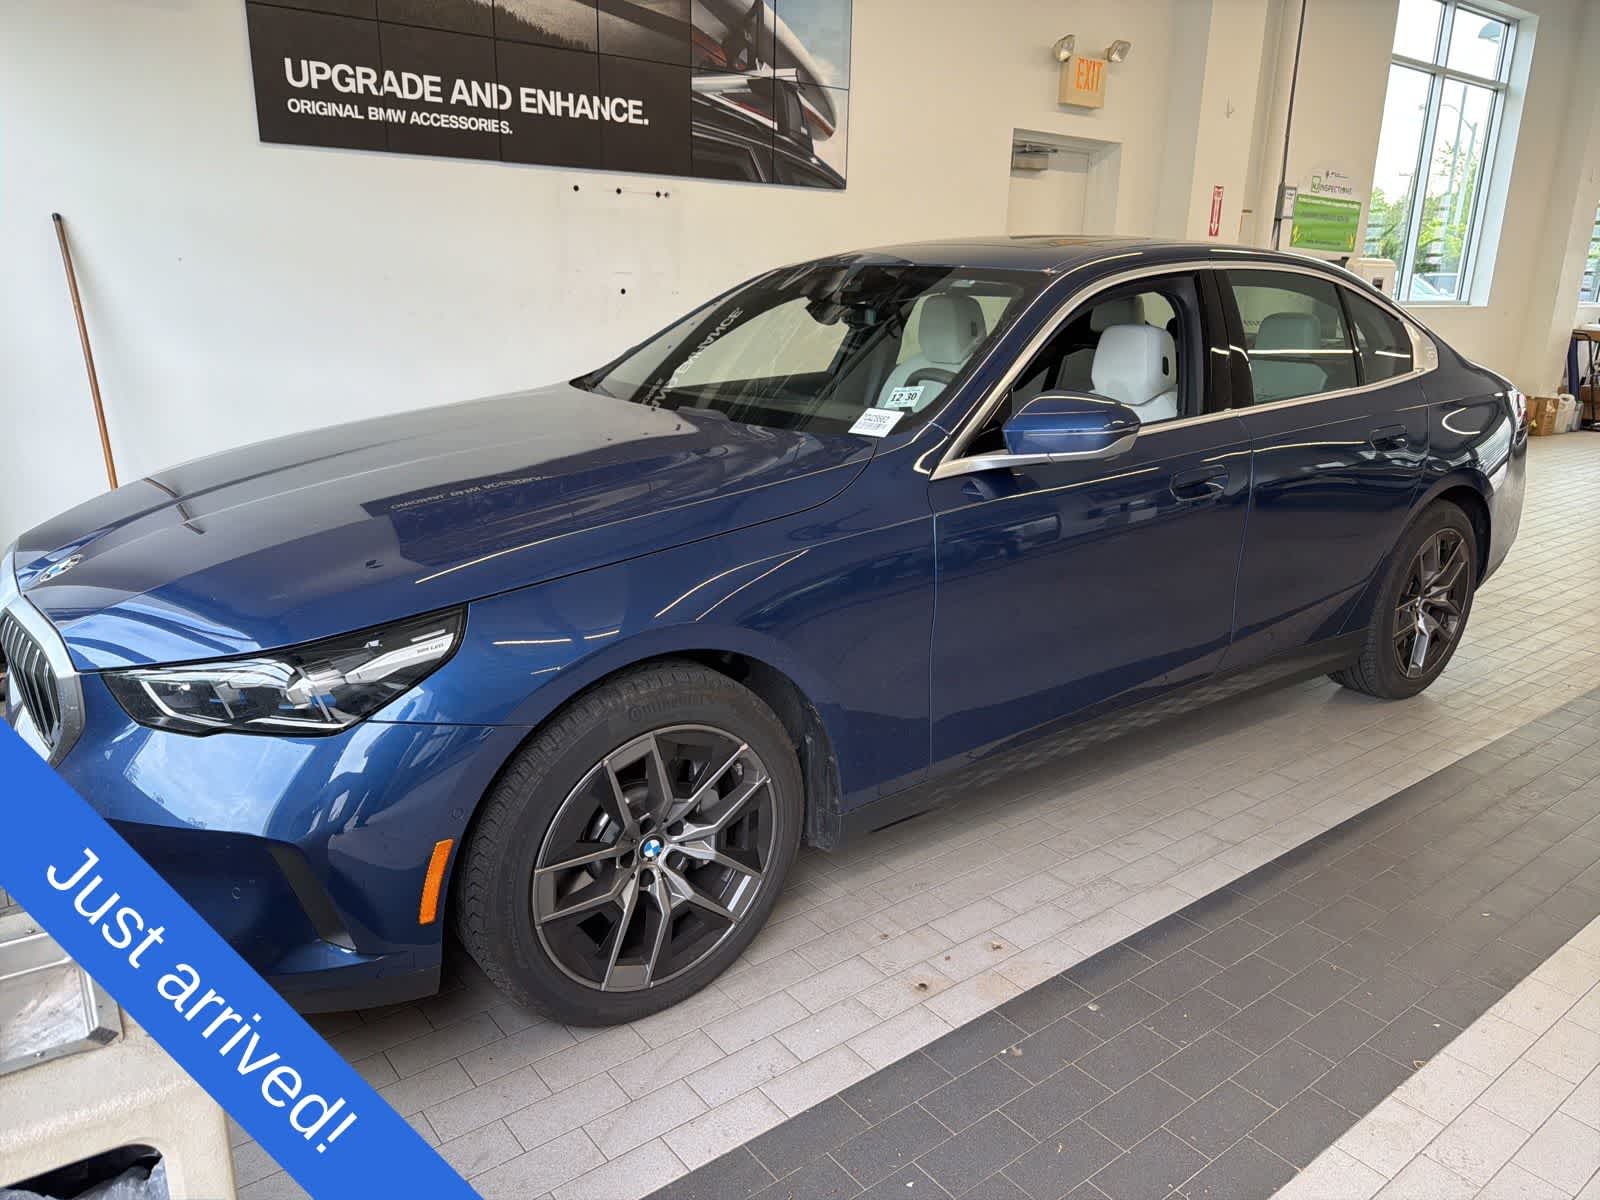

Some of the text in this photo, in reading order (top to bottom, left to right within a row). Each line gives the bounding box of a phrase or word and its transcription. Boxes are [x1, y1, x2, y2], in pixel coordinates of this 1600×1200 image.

[284, 57, 649, 126] UPGRADE AND ENHANCE.
[1075, 56, 1104, 92] EXIT
[287, 98, 513, 135] ORIGINAL BMW ACCESSORIES.
[890, 391, 918, 402] 12 30
